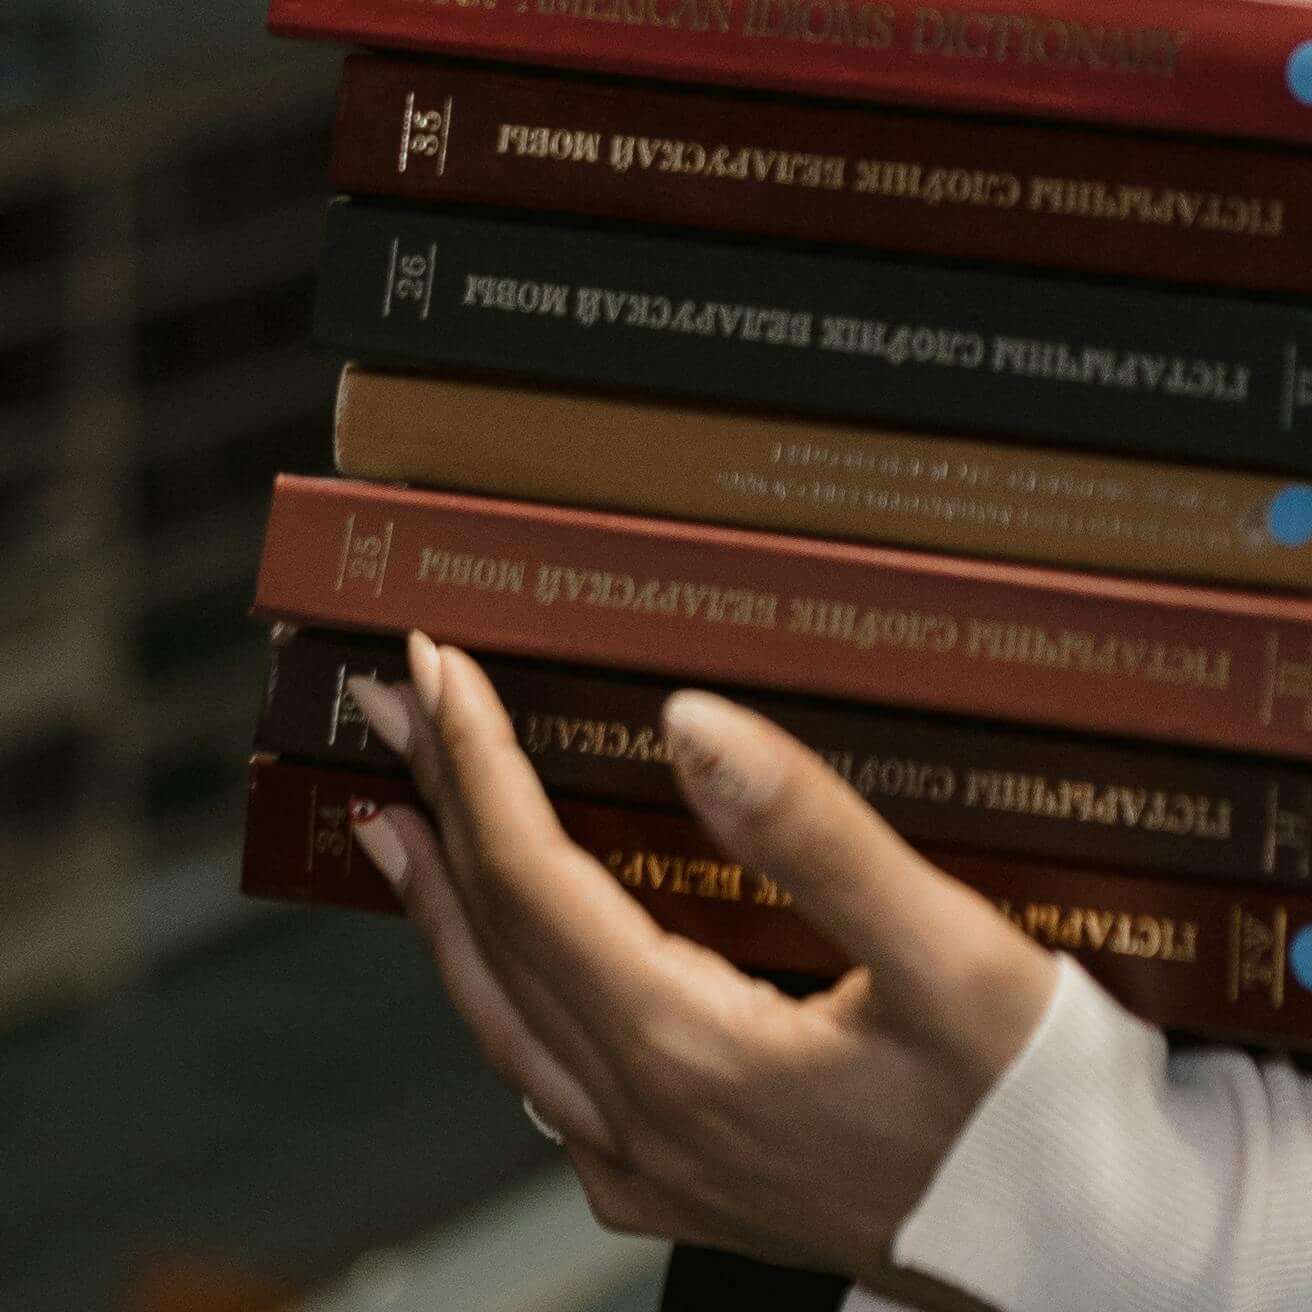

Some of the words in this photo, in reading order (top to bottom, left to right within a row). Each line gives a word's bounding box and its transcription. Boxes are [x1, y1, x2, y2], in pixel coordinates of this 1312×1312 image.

[911, 6, 1192, 75] DICTIONARY
[409, 108, 443, 157] 35
[497, 123, 601, 164] МОВЫ
[610, 133, 848, 191] БЕЛАРУСКАЙ
[854, 159, 1021, 210] СЛОЎНІК
[1027, 176, 1285, 236] ГІСТАРЫЧНЫ
[396, 253, 427, 301] 26
[461, 274, 570, 317] МОВЫ
[575, 286, 814, 347] БЕЛАРУСКАЙ
[819, 316, 985, 369] СЛОЎНІК
[350, 534, 382, 581] 25
[416, 546, 528, 594] МОВЫ
[535, 560, 778, 630] БЕЛАРУСКАЙ
[786, 596, 961, 653] СЛОЎНІК
[963, 767, 1232, 841] ГІСТАРЫЧНЫ
